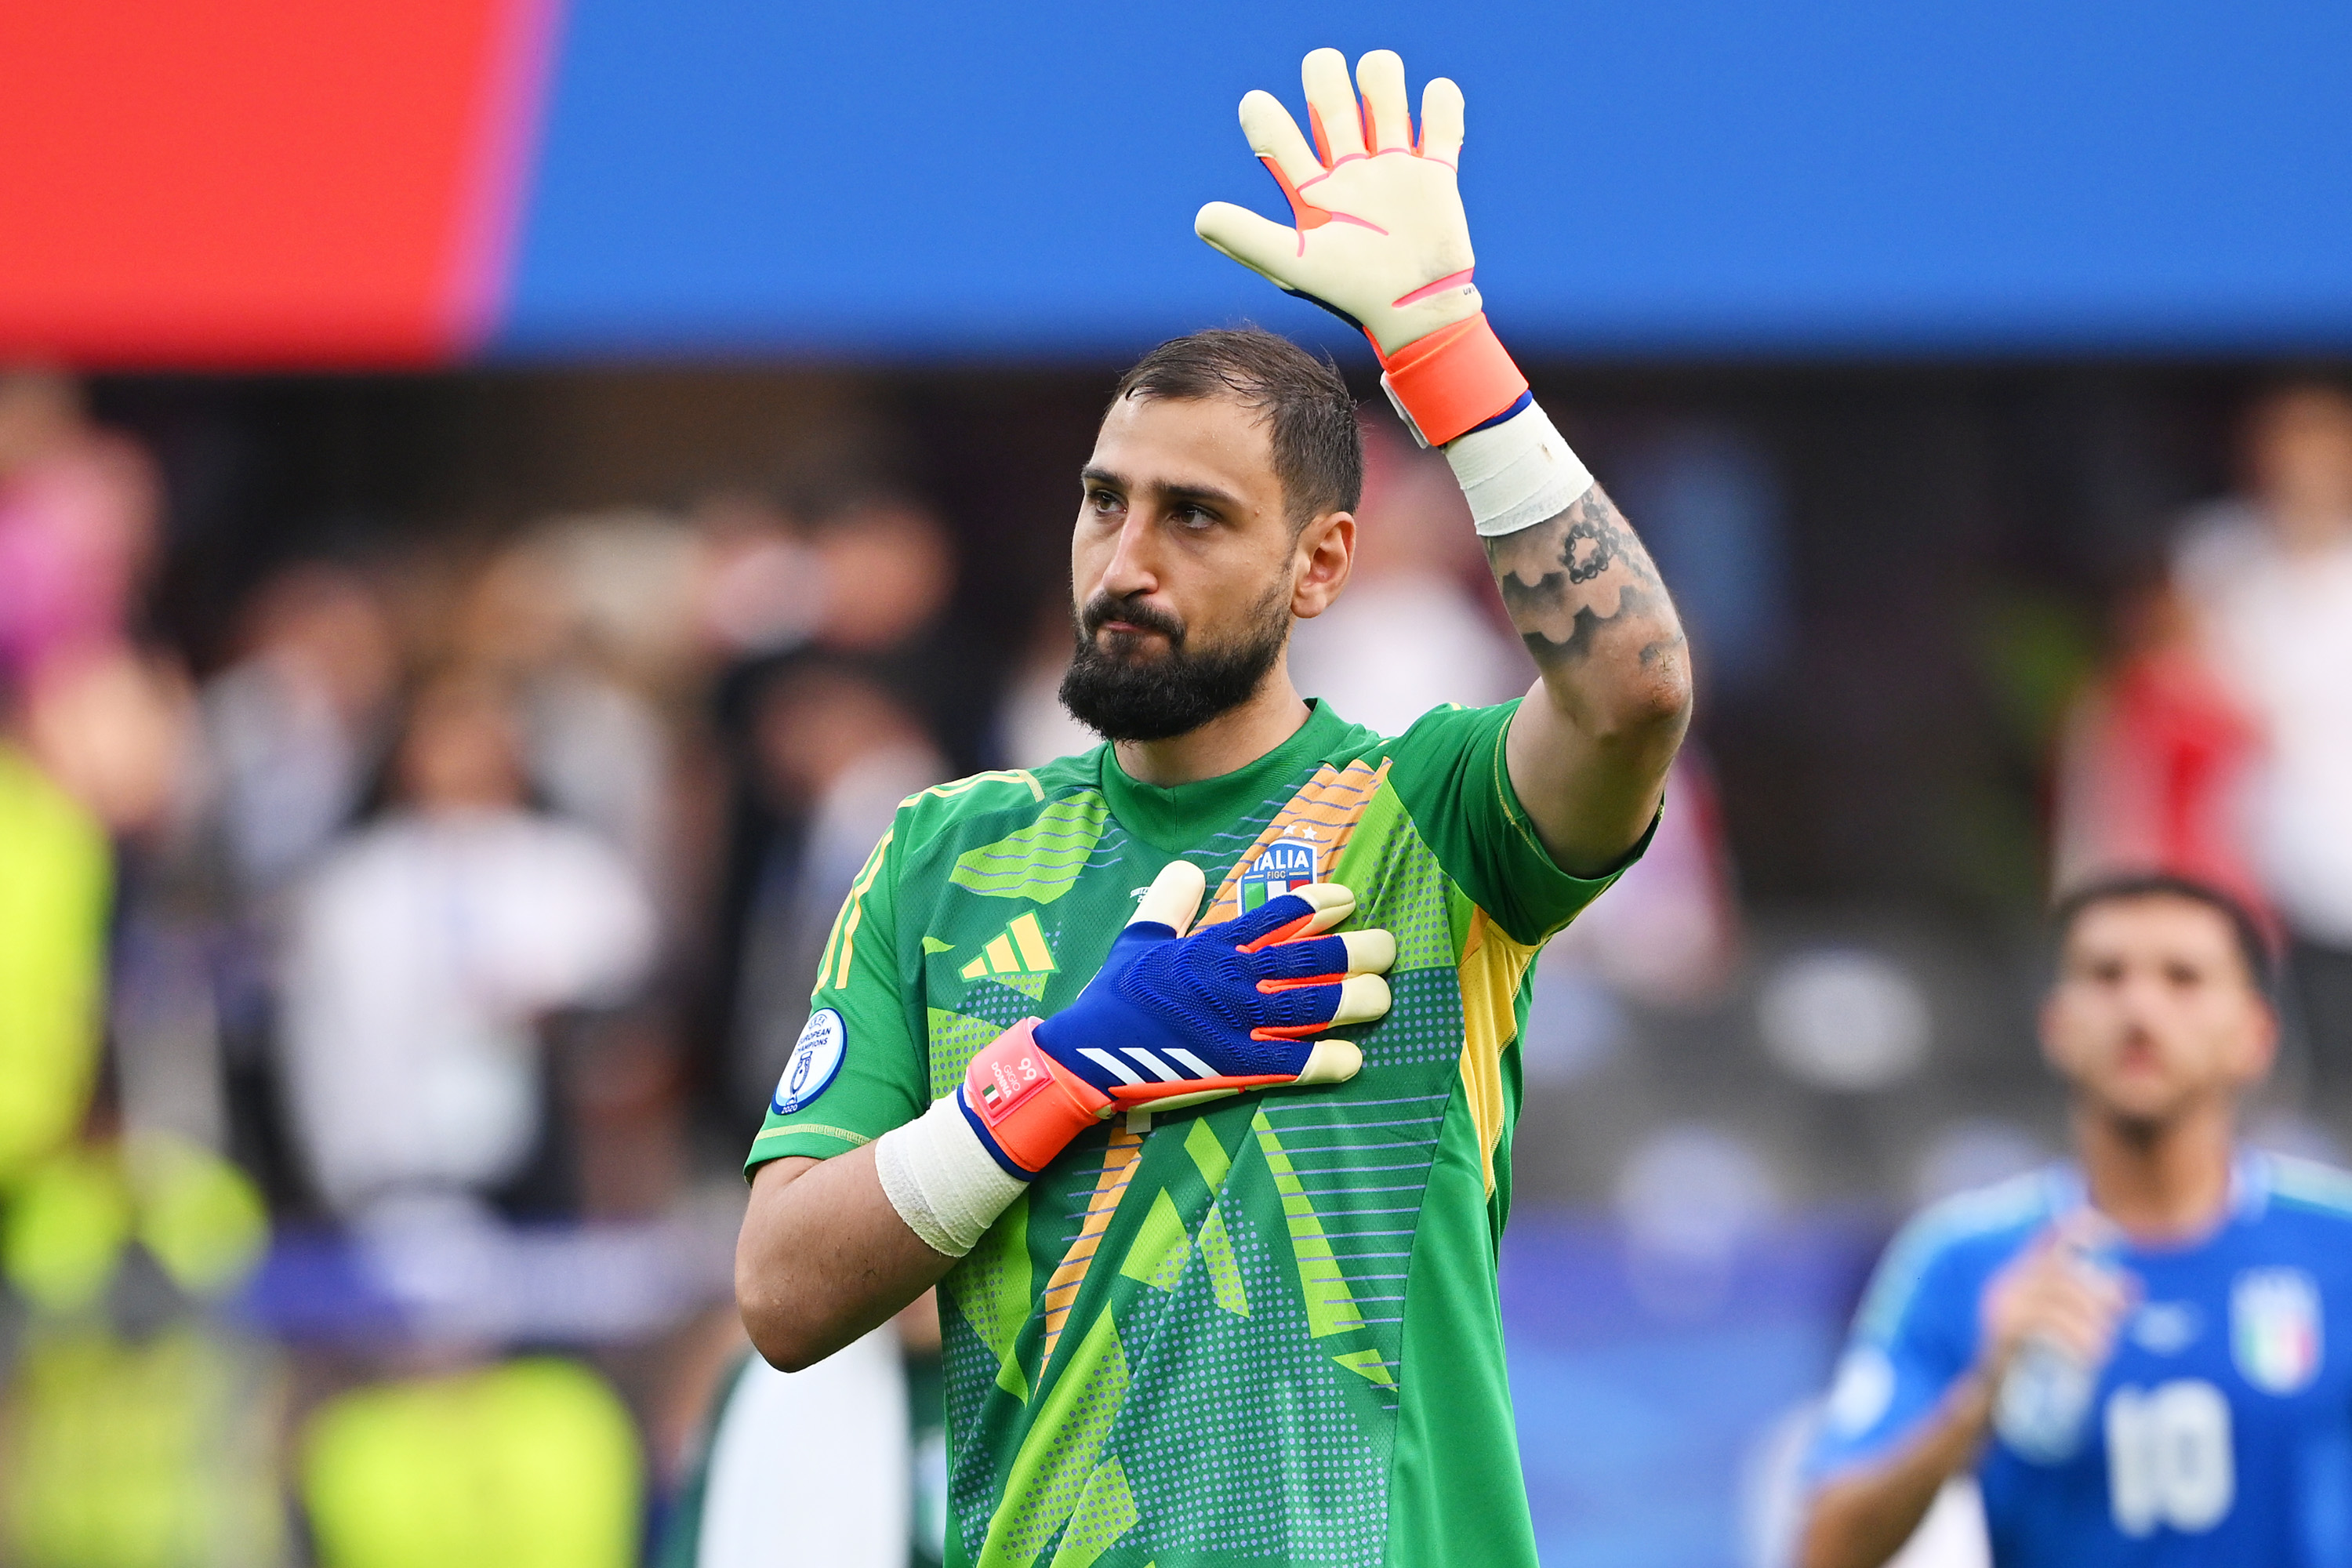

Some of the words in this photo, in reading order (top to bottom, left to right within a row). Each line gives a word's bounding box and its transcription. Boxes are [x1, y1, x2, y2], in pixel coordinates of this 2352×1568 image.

[1267, 870, 1287, 880] FIGC
[991, 1061, 1012, 1098] DONNA
[1004, 1065, 1021, 1091] GIGIO
[1017, 1058, 1037, 1080] 99
[781, 1104, 798, 1114] 2020
[2105, 1377, 2235, 1538] 10
